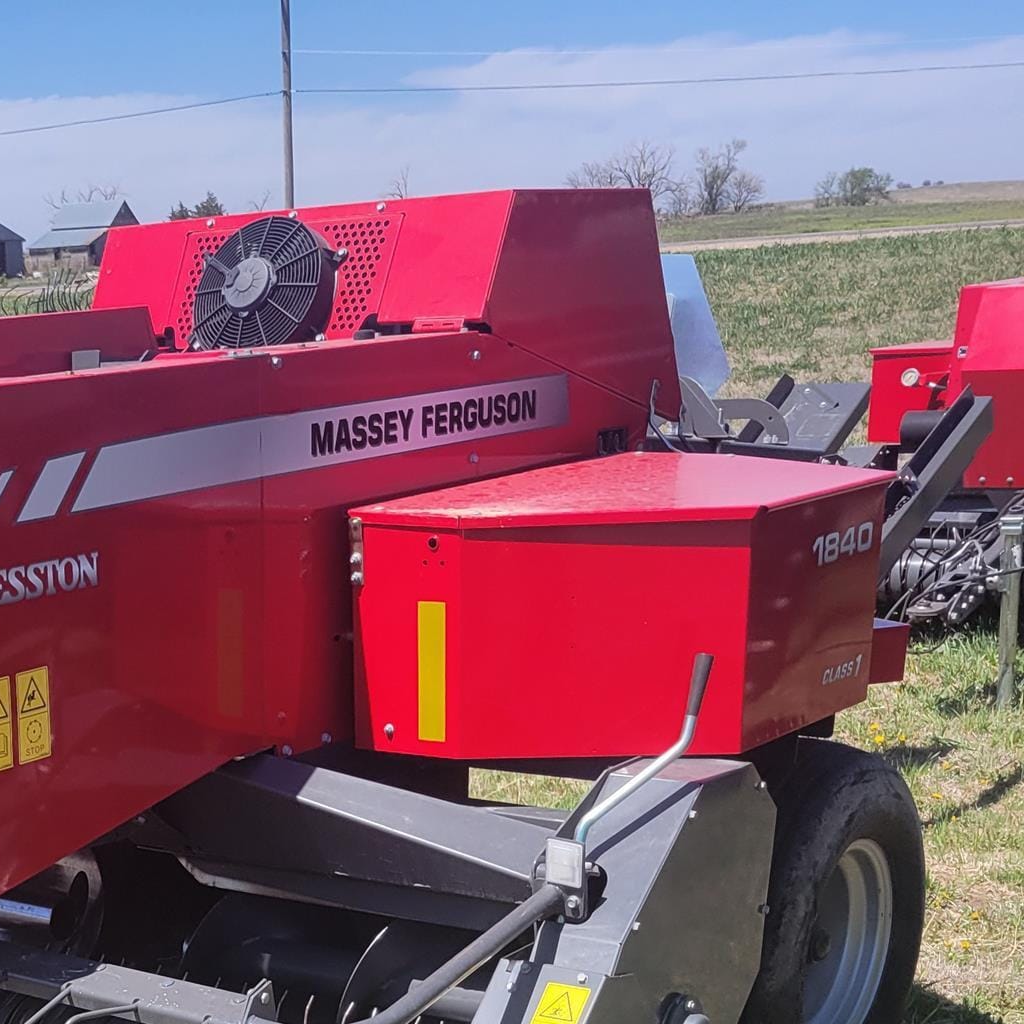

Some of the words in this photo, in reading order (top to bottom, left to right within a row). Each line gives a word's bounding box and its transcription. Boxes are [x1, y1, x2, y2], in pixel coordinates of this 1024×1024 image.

[310, 408, 414, 458] MASSEY
[421, 389, 537, 439] FERGUSON
[813, 521, 874, 567] 1840
[822, 659, 854, 685] CLASS
[854, 654, 863, 677] 1
[25, 743, 45, 756] STOP
